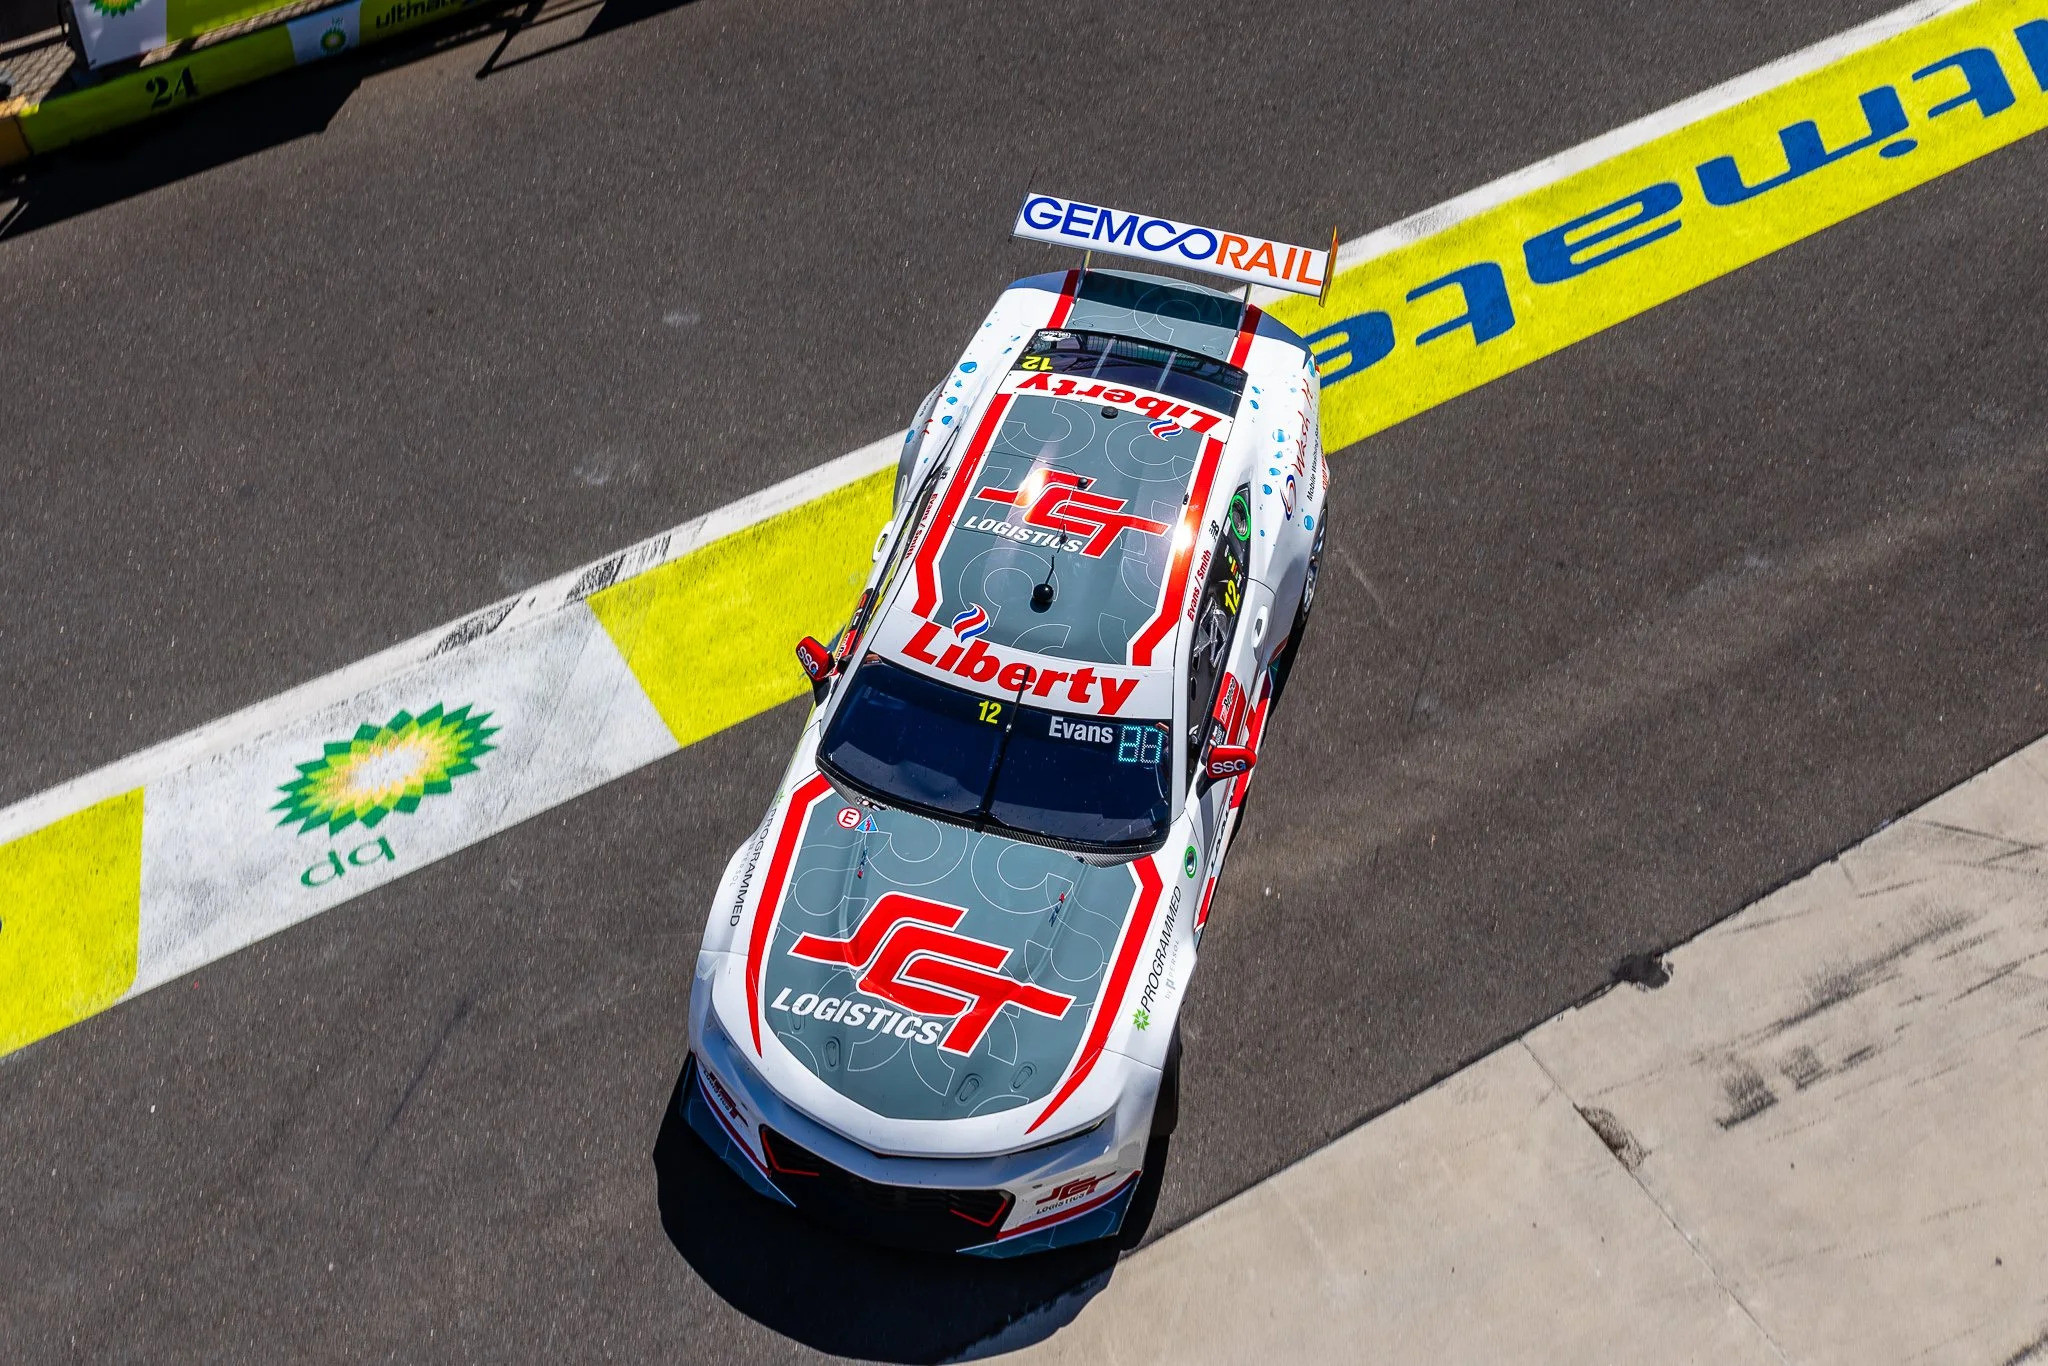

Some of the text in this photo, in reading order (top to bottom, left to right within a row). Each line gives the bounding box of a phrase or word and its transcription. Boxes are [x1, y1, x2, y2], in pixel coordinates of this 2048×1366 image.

[146, 64, 199, 109] 24
[1021, 356, 1054, 372] 12
[1016, 371, 1223, 434] Liberty
[1306, 473, 1316, 501] Mobile
[963, 515, 1085, 553] LOGISTICS
[1187, 586, 1200, 622] Evans
[1197, 549, 1212, 579] Smith
[1225, 580, 1240, 615] 12
[901, 620, 1140, 714] Liberty
[978, 700, 1002, 725] 12
[1049, 716, 1113, 744] Evans
[1212, 759, 1247, 774] SSG
[300, 835, 395, 887] bp
[729, 807, 777, 927] PROGRAMMED
[1140, 885, 1182, 1013] PROGRAMMED
[771, 987, 944, 1046] LOGISTICS
